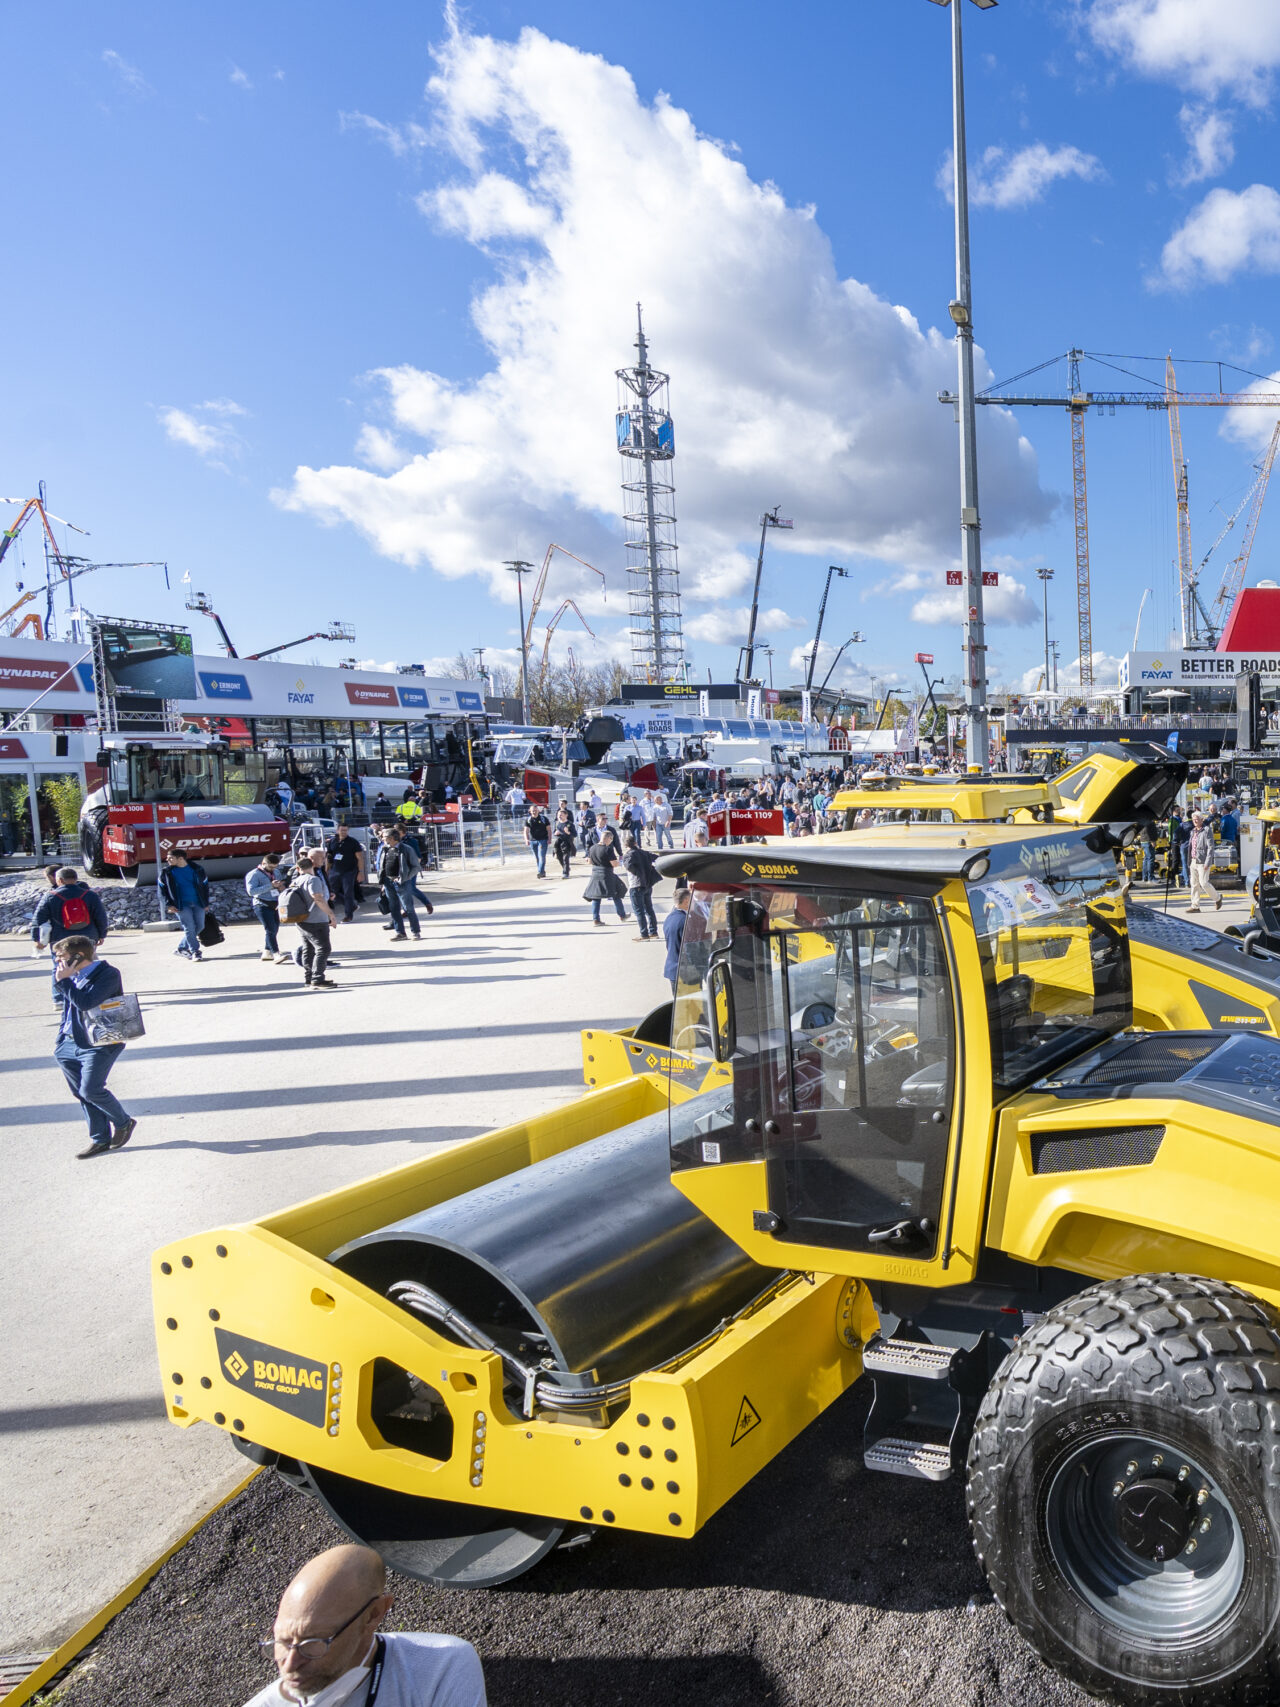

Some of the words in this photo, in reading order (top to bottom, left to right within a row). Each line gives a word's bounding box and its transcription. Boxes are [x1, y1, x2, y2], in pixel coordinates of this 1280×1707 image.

[1181, 659, 1234, 673] BETTER
[1141, 671, 1173, 680] FAYAT
[219, 682, 241, 690] ERMONT
[664, 686, 697, 694] GEHL
[288, 692, 314, 704] FAYAT
[359, 691, 390, 700] DYNAPAC
[731, 811, 752, 819] Block
[754, 811, 773, 819] 1109
[175, 833, 272, 849] DYNAPAC
[1034, 842, 1070, 862] BOMAG
[757, 864, 799, 875] BOMAG
[660, 1057, 695, 1070] BOMAG
[253, 1360, 323, 1391] BOMAG
[254, 1380, 275, 1391] FAYAT
[276, 1384, 300, 1395] GROUP
